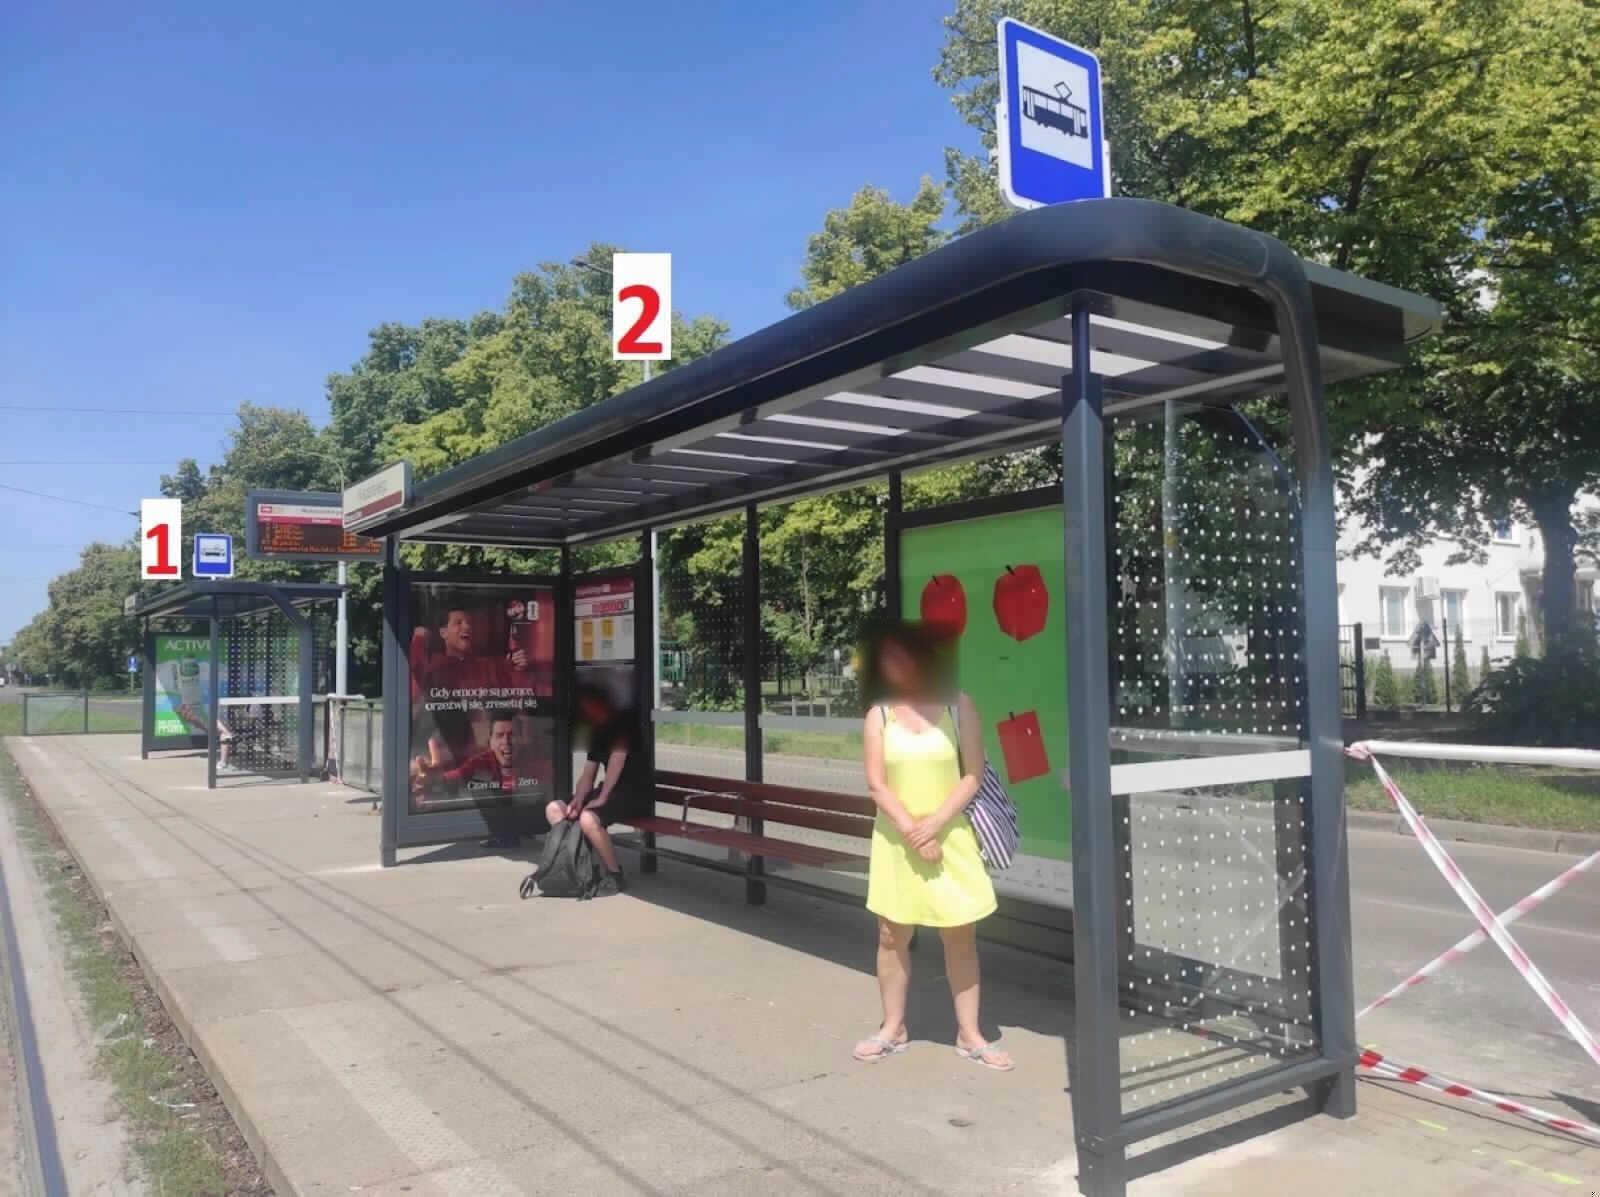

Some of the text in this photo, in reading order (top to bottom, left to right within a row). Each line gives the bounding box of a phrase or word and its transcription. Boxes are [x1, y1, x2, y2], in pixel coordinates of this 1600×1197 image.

[430, 687, 450, 699] Gdy
[452, 687, 488, 698] emocje
[518, 776, 538, 786] Zero
